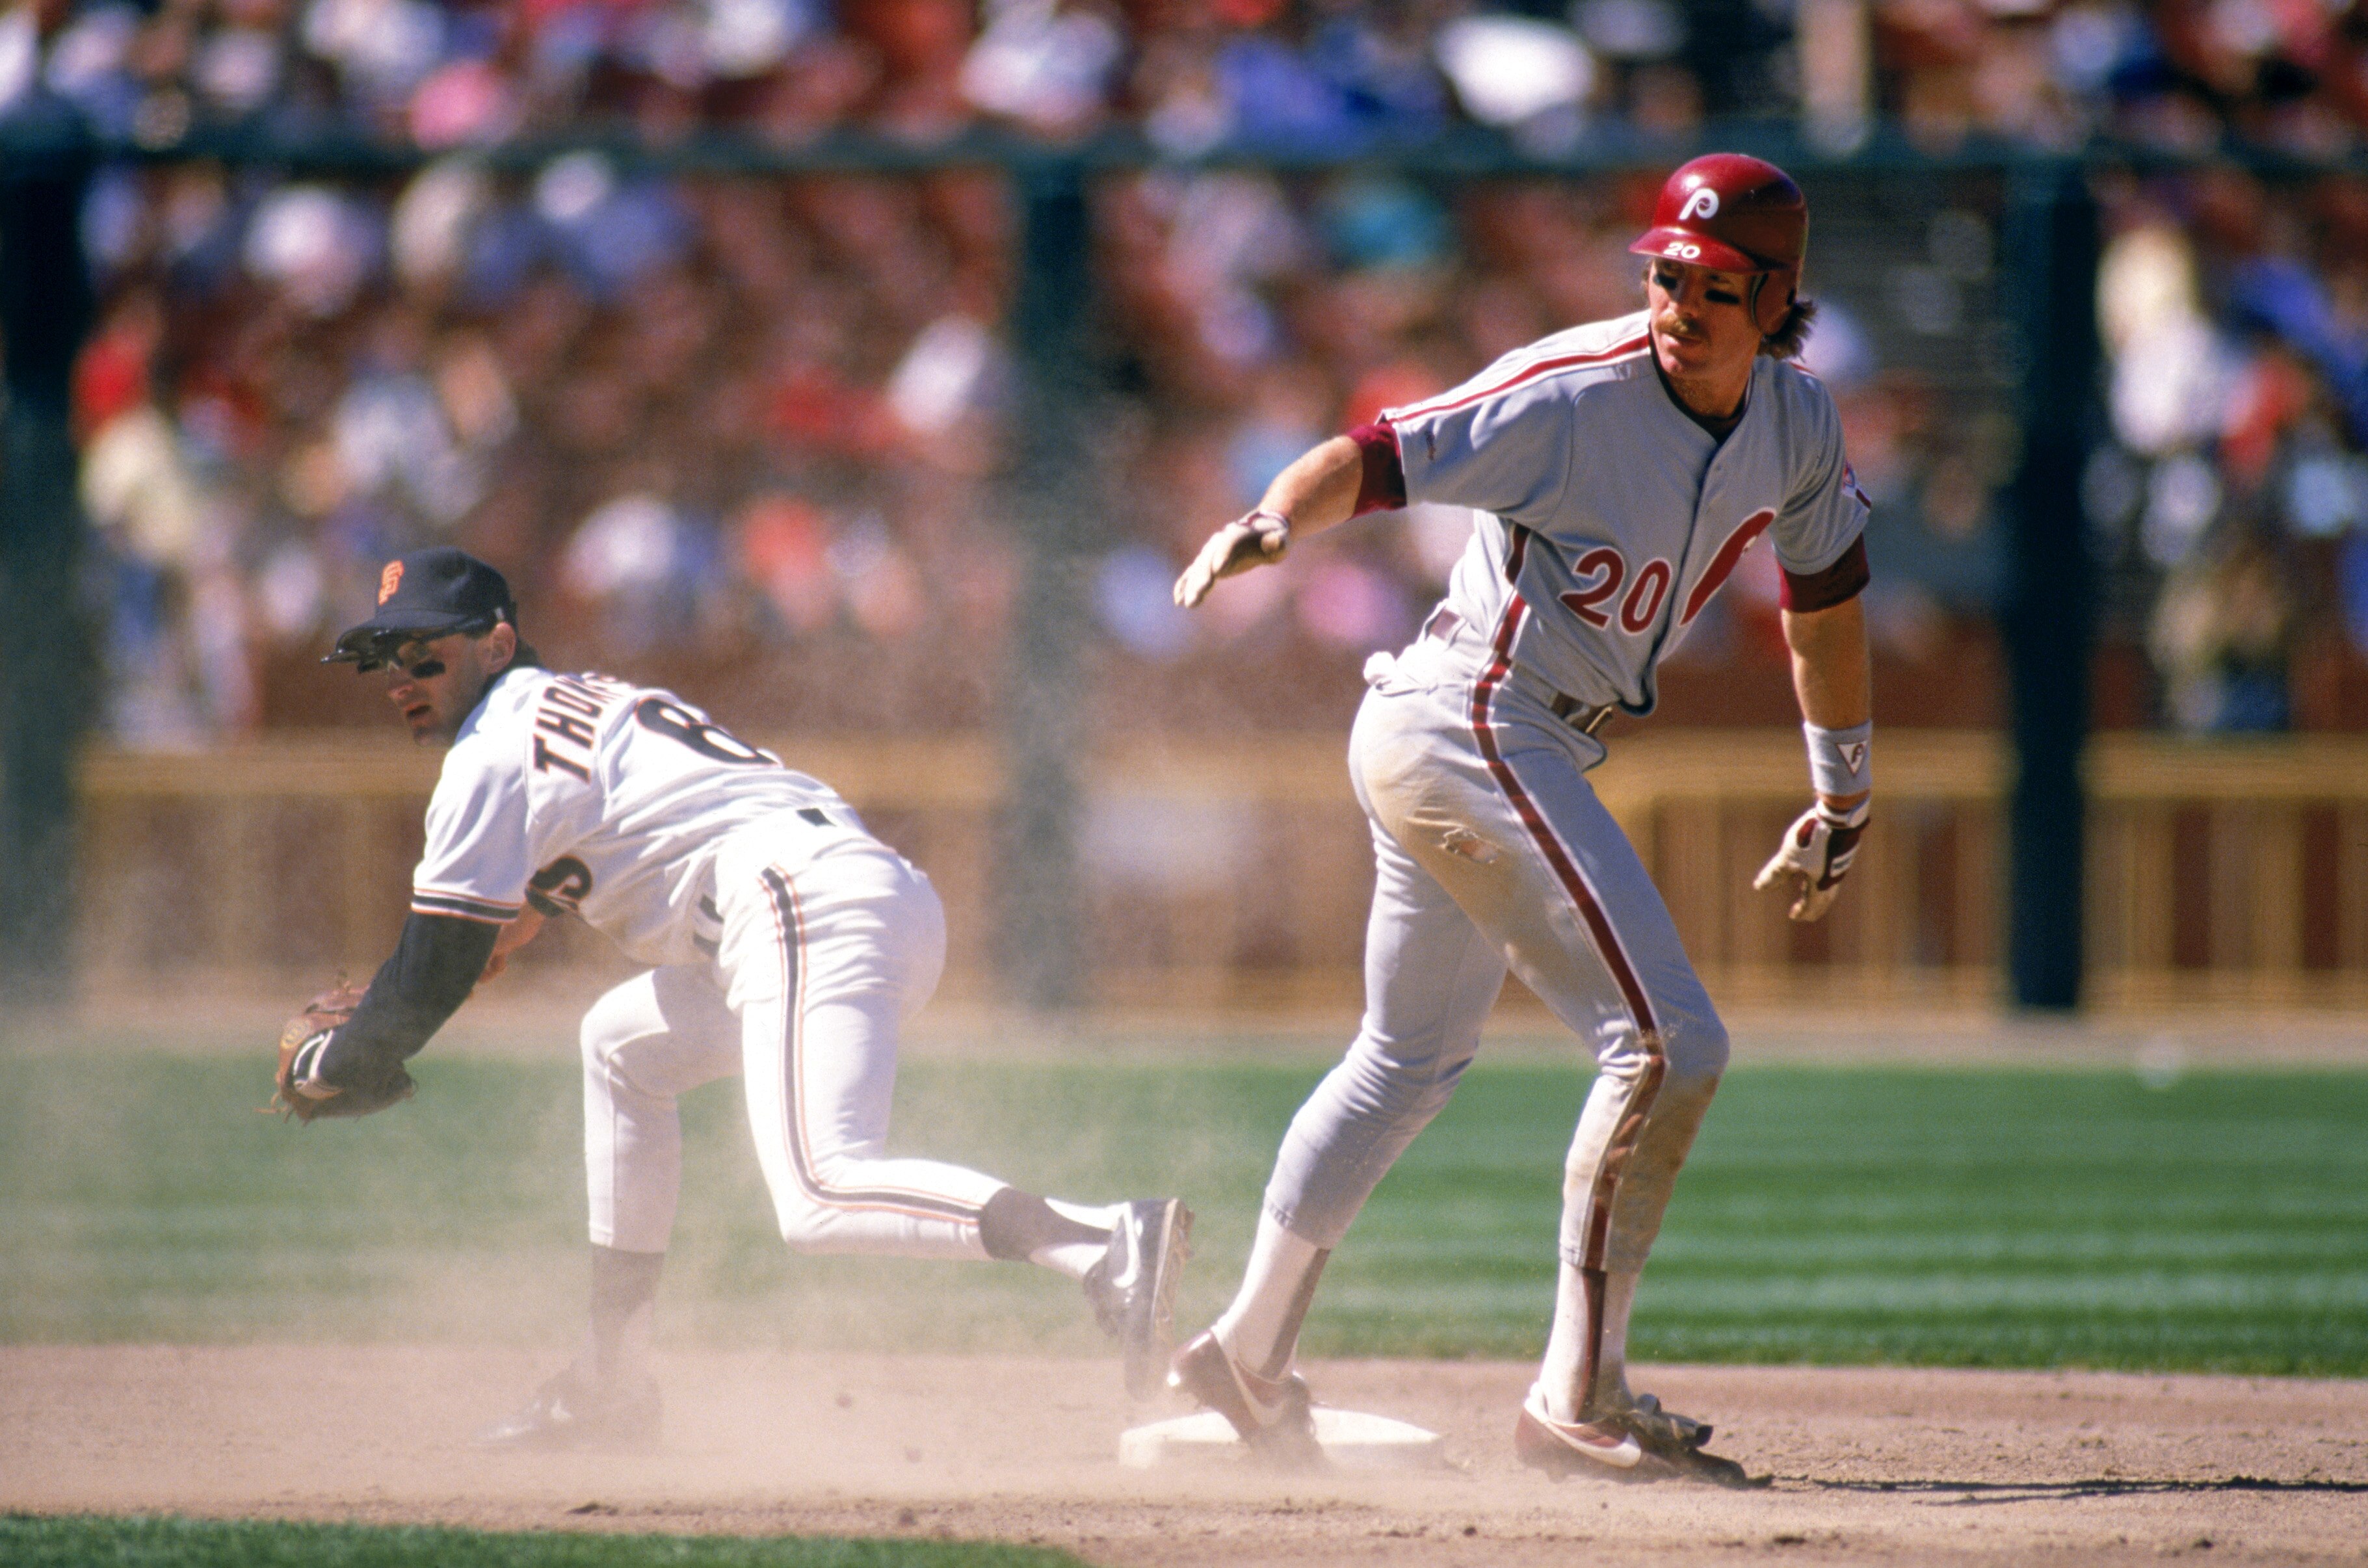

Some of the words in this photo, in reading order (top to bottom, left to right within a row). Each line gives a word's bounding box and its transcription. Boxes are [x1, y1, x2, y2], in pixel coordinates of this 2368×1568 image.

[1679, 187, 1719, 220] P
[1663, 242, 1700, 259] 20
[1558, 546, 1672, 636] 20
